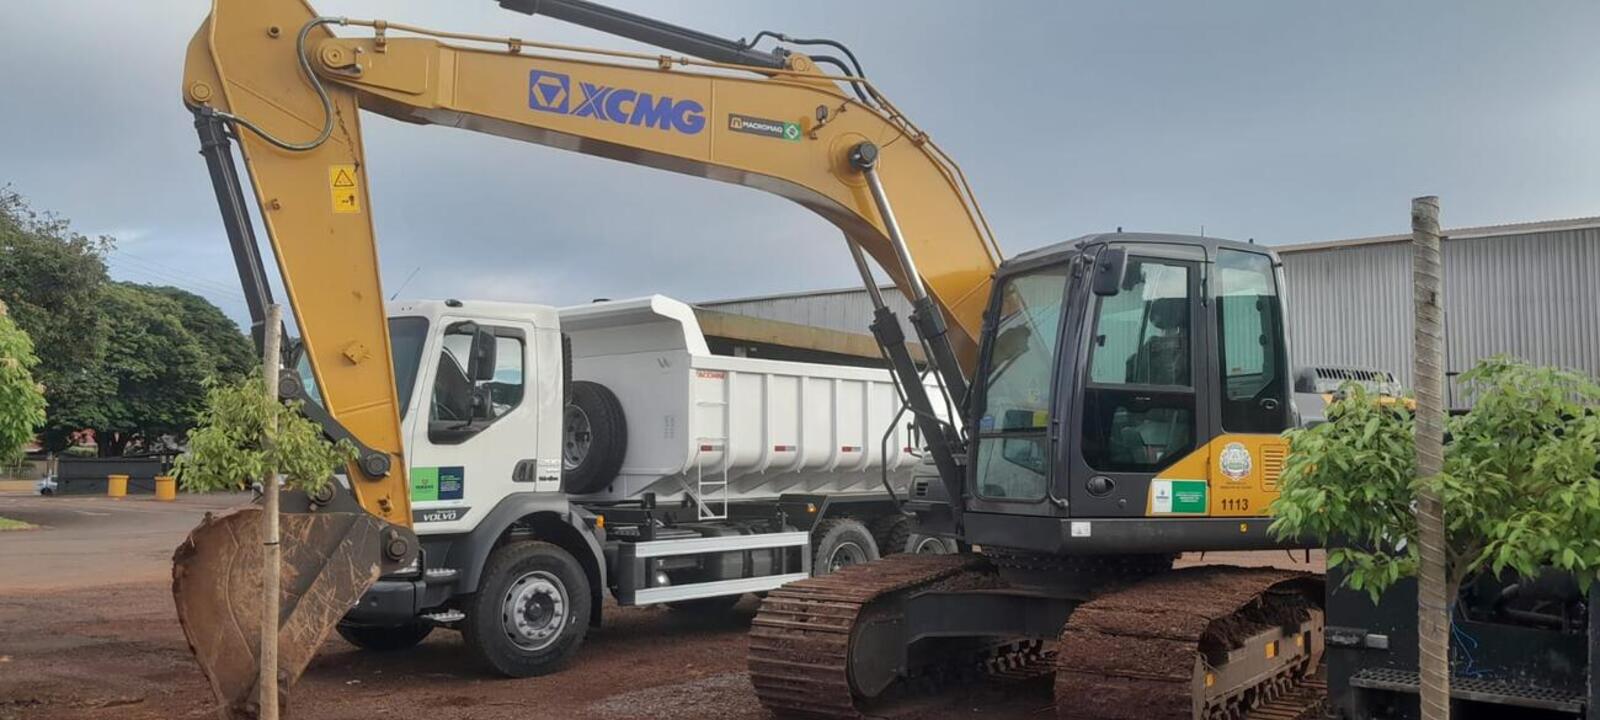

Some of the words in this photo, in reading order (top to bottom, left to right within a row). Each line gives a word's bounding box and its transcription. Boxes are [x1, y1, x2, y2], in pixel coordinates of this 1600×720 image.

[570, 82, 705, 134] XCMG
[742, 121, 784, 134] MACROMAQ
[1221, 498, 1249, 512] 1113
[423, 512, 457, 522] VOLVO
